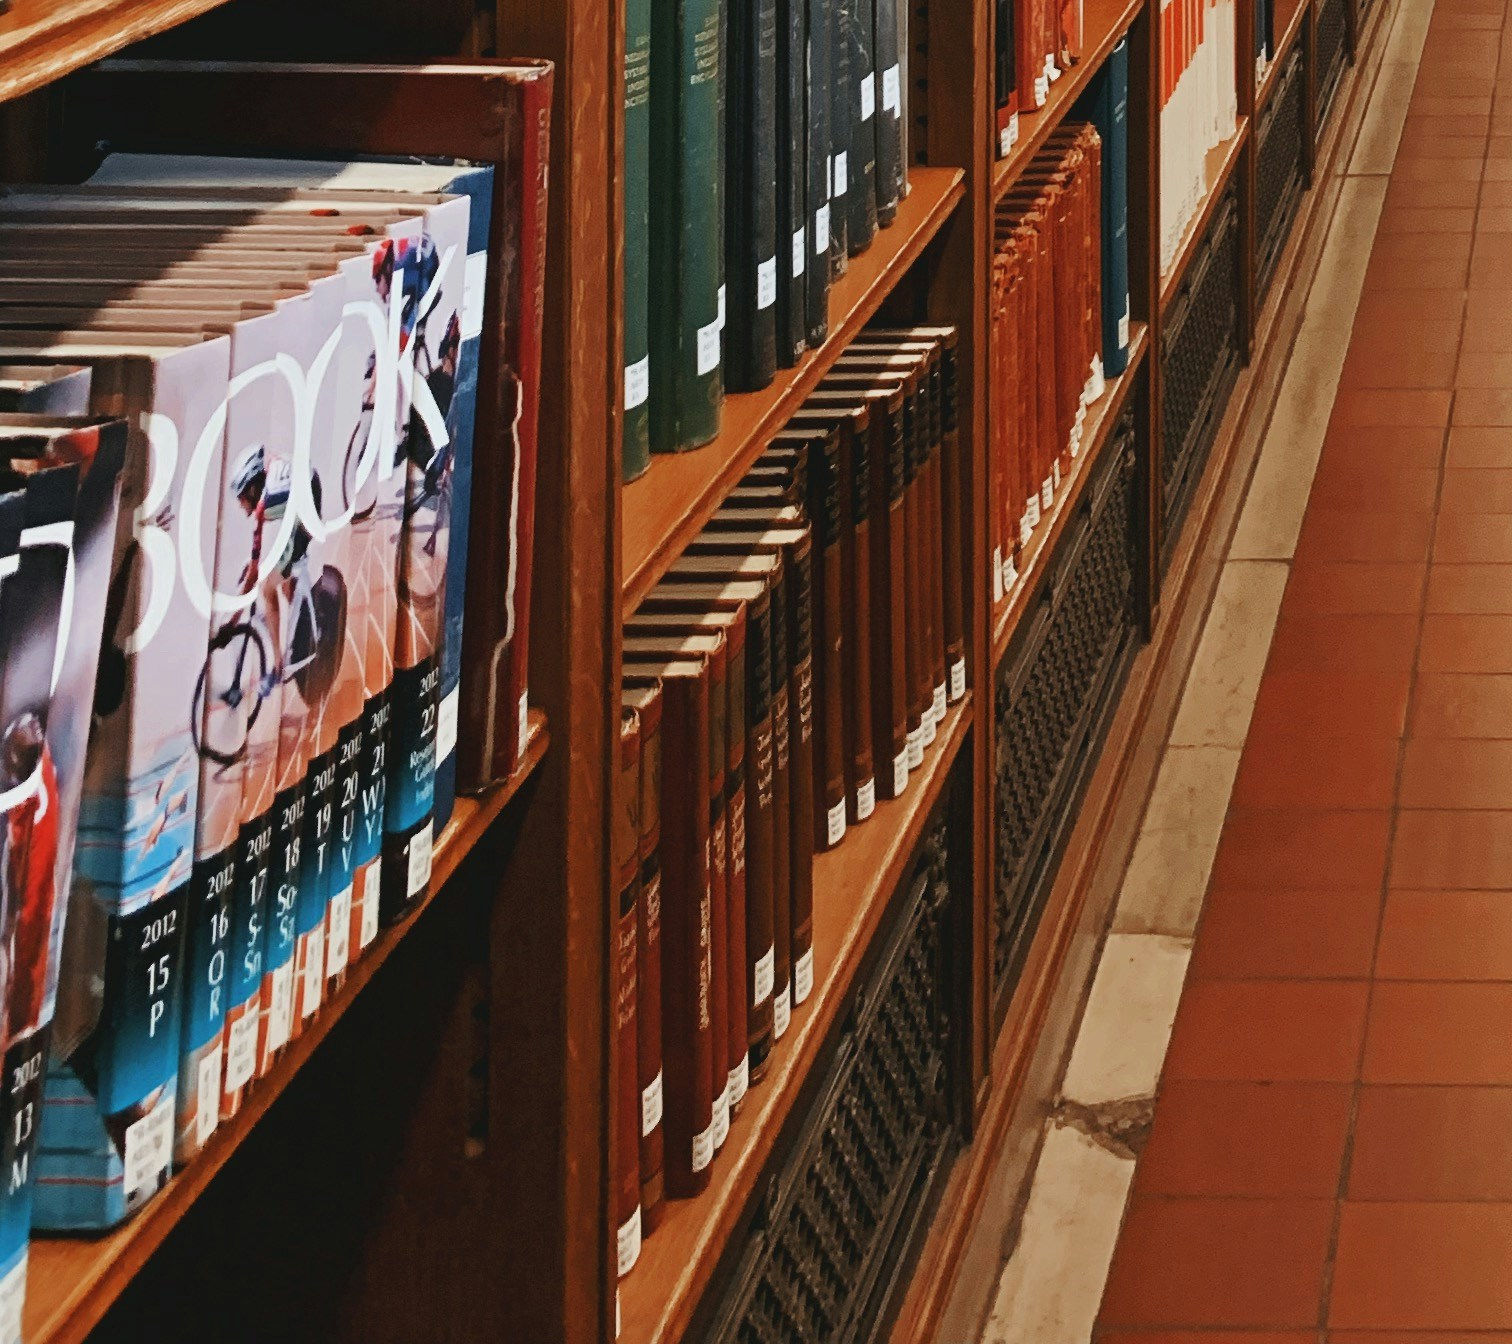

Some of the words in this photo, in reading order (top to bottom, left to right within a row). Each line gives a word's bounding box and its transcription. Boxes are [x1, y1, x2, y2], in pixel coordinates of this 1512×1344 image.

[371, 741, 385, 776] 21
[341, 770, 358, 808] 20
[316, 802, 331, 839] 19
[342, 810, 354, 842] U
[246, 826, 272, 863] 2012
[285, 836, 300, 873] 18
[317, 842, 326, 875] T
[342, 842, 352, 873] V
[206, 863, 234, 901] 2012
[250, 867, 267, 906] 17
[141, 909, 177, 951] 2012
[210, 905, 228, 945] 16
[147, 954, 170, 996] 15
[149, 1000, 164, 1038] P
[210, 986, 221, 1021] R
[10, 1052, 41, 1094] 2012
[15, 1101, 33, 1146] 13
[9, 1151, 28, 1196] M
